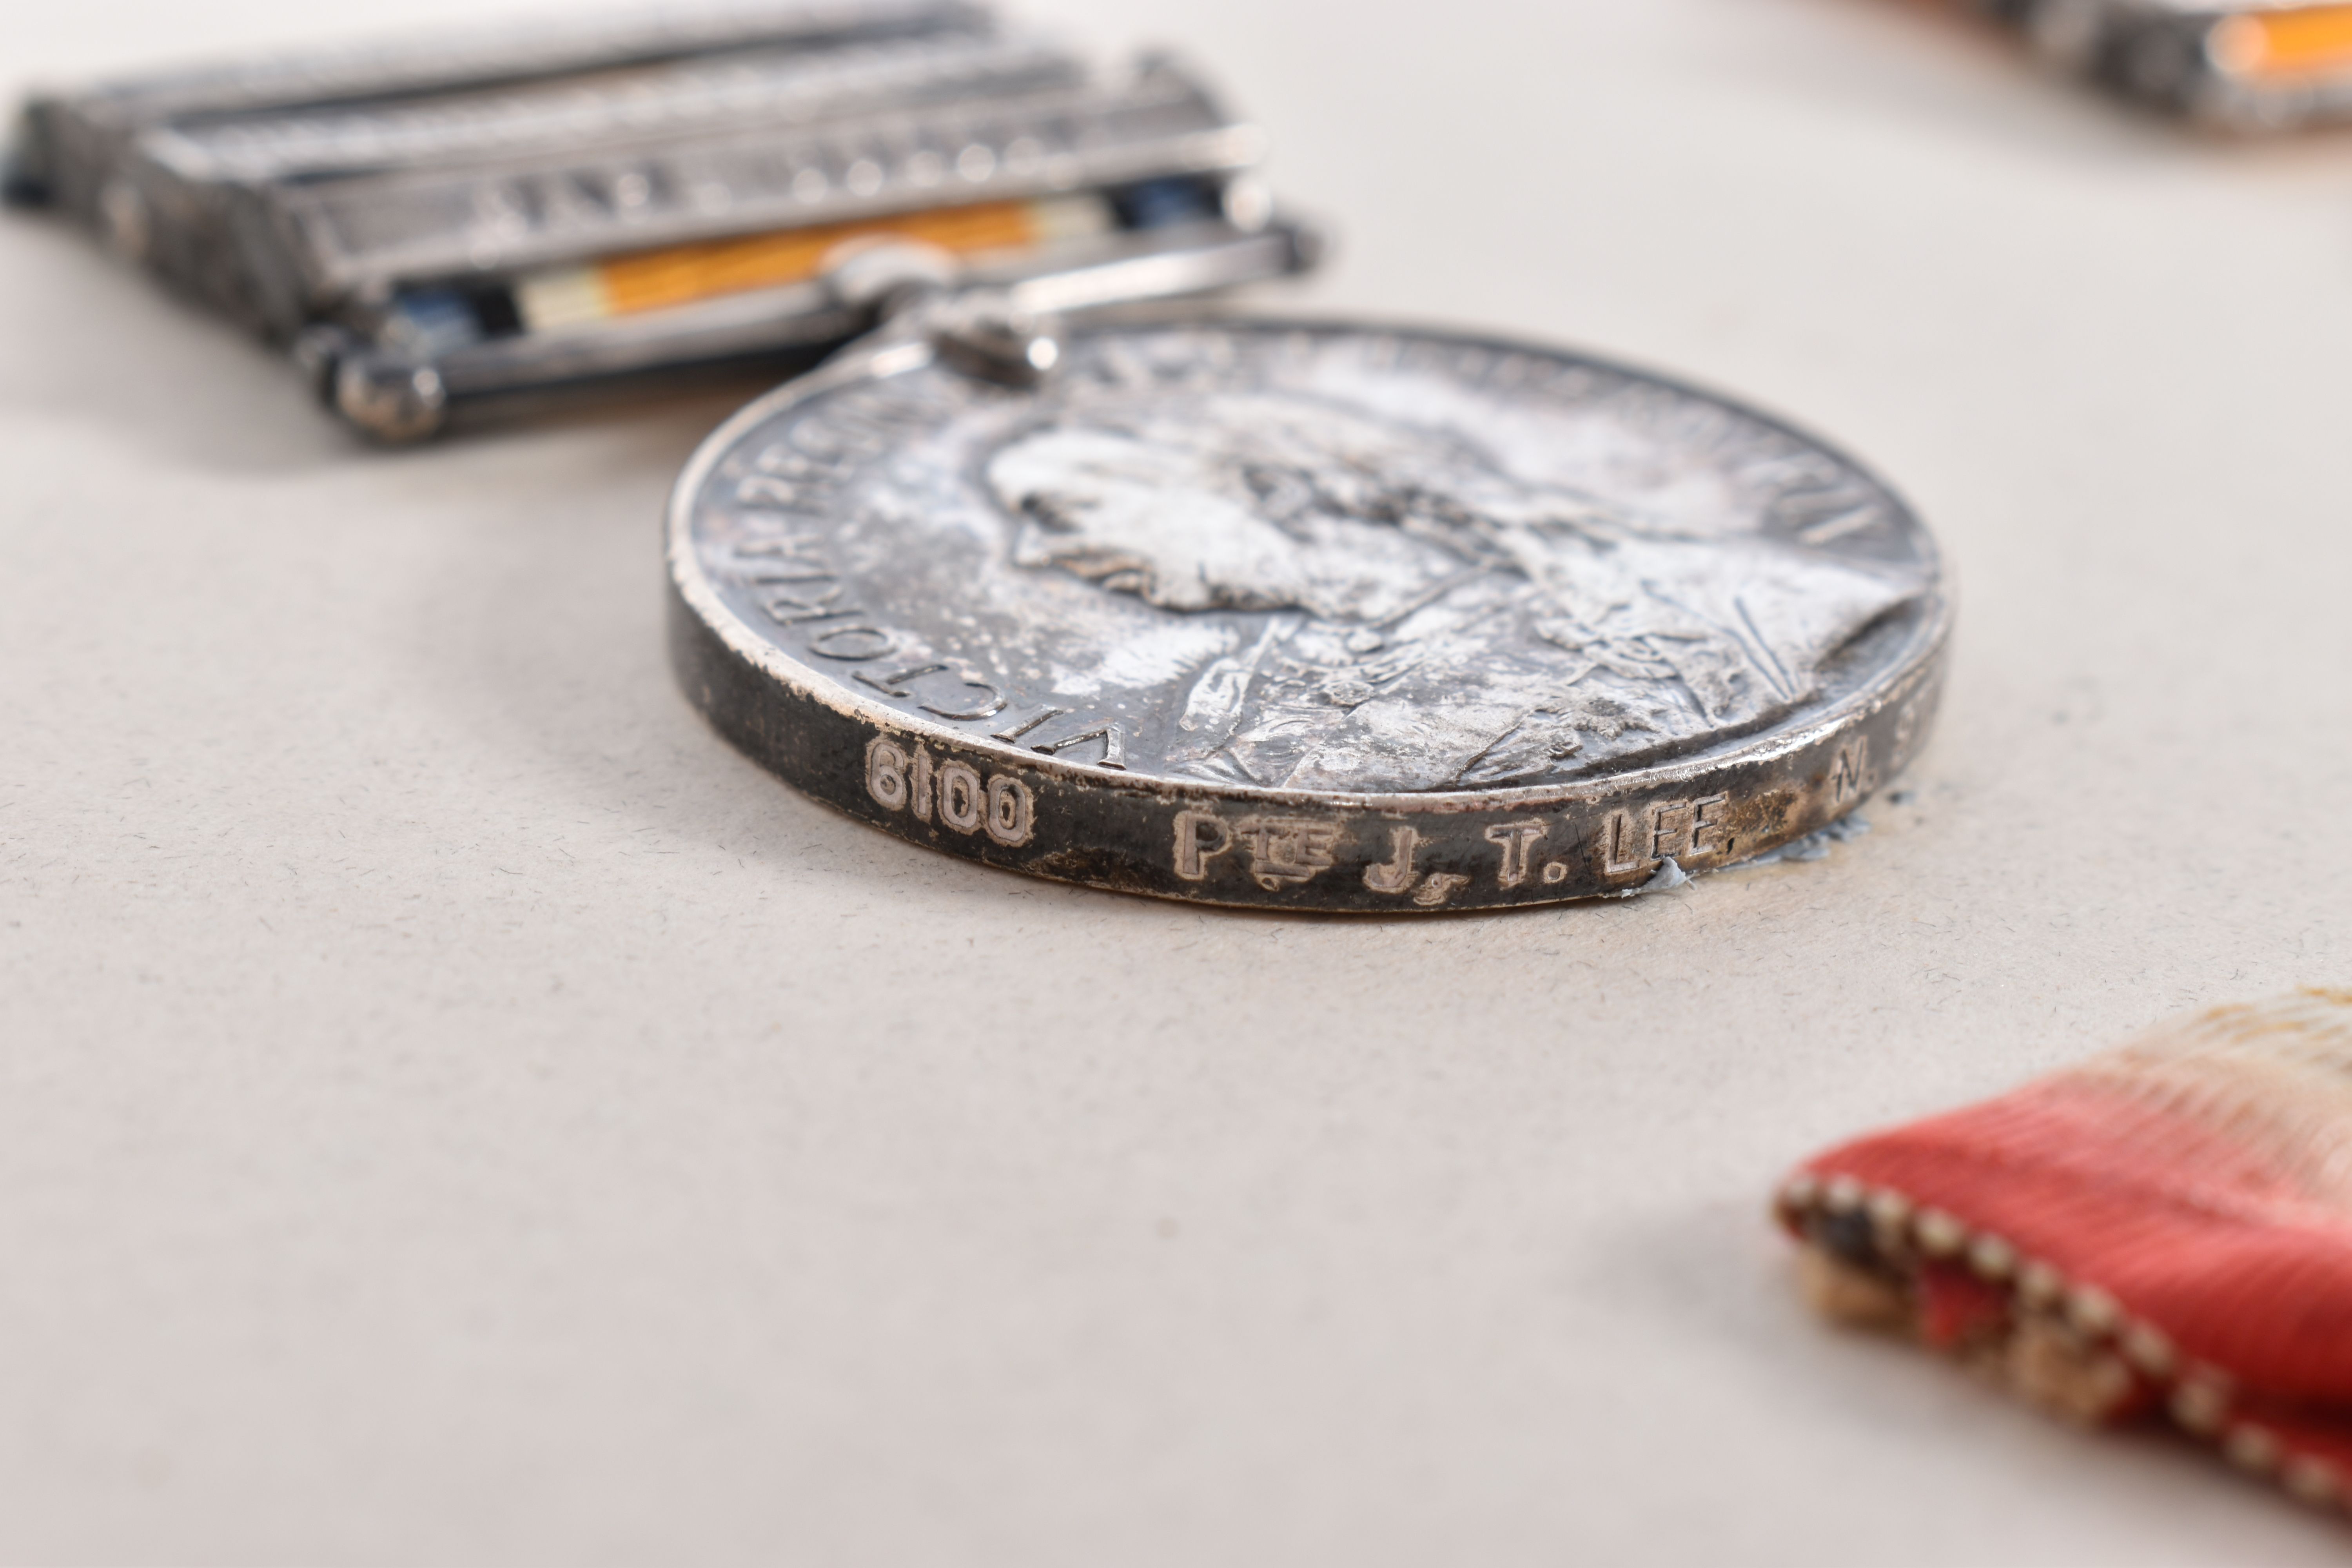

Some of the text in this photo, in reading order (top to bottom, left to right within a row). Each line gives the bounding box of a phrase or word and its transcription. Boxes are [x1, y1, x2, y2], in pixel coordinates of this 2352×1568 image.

[732, 532, 1128, 771] VICTORIA
[869, 741, 1029, 844] 6100
[1487, 822, 1563, 884] T.
